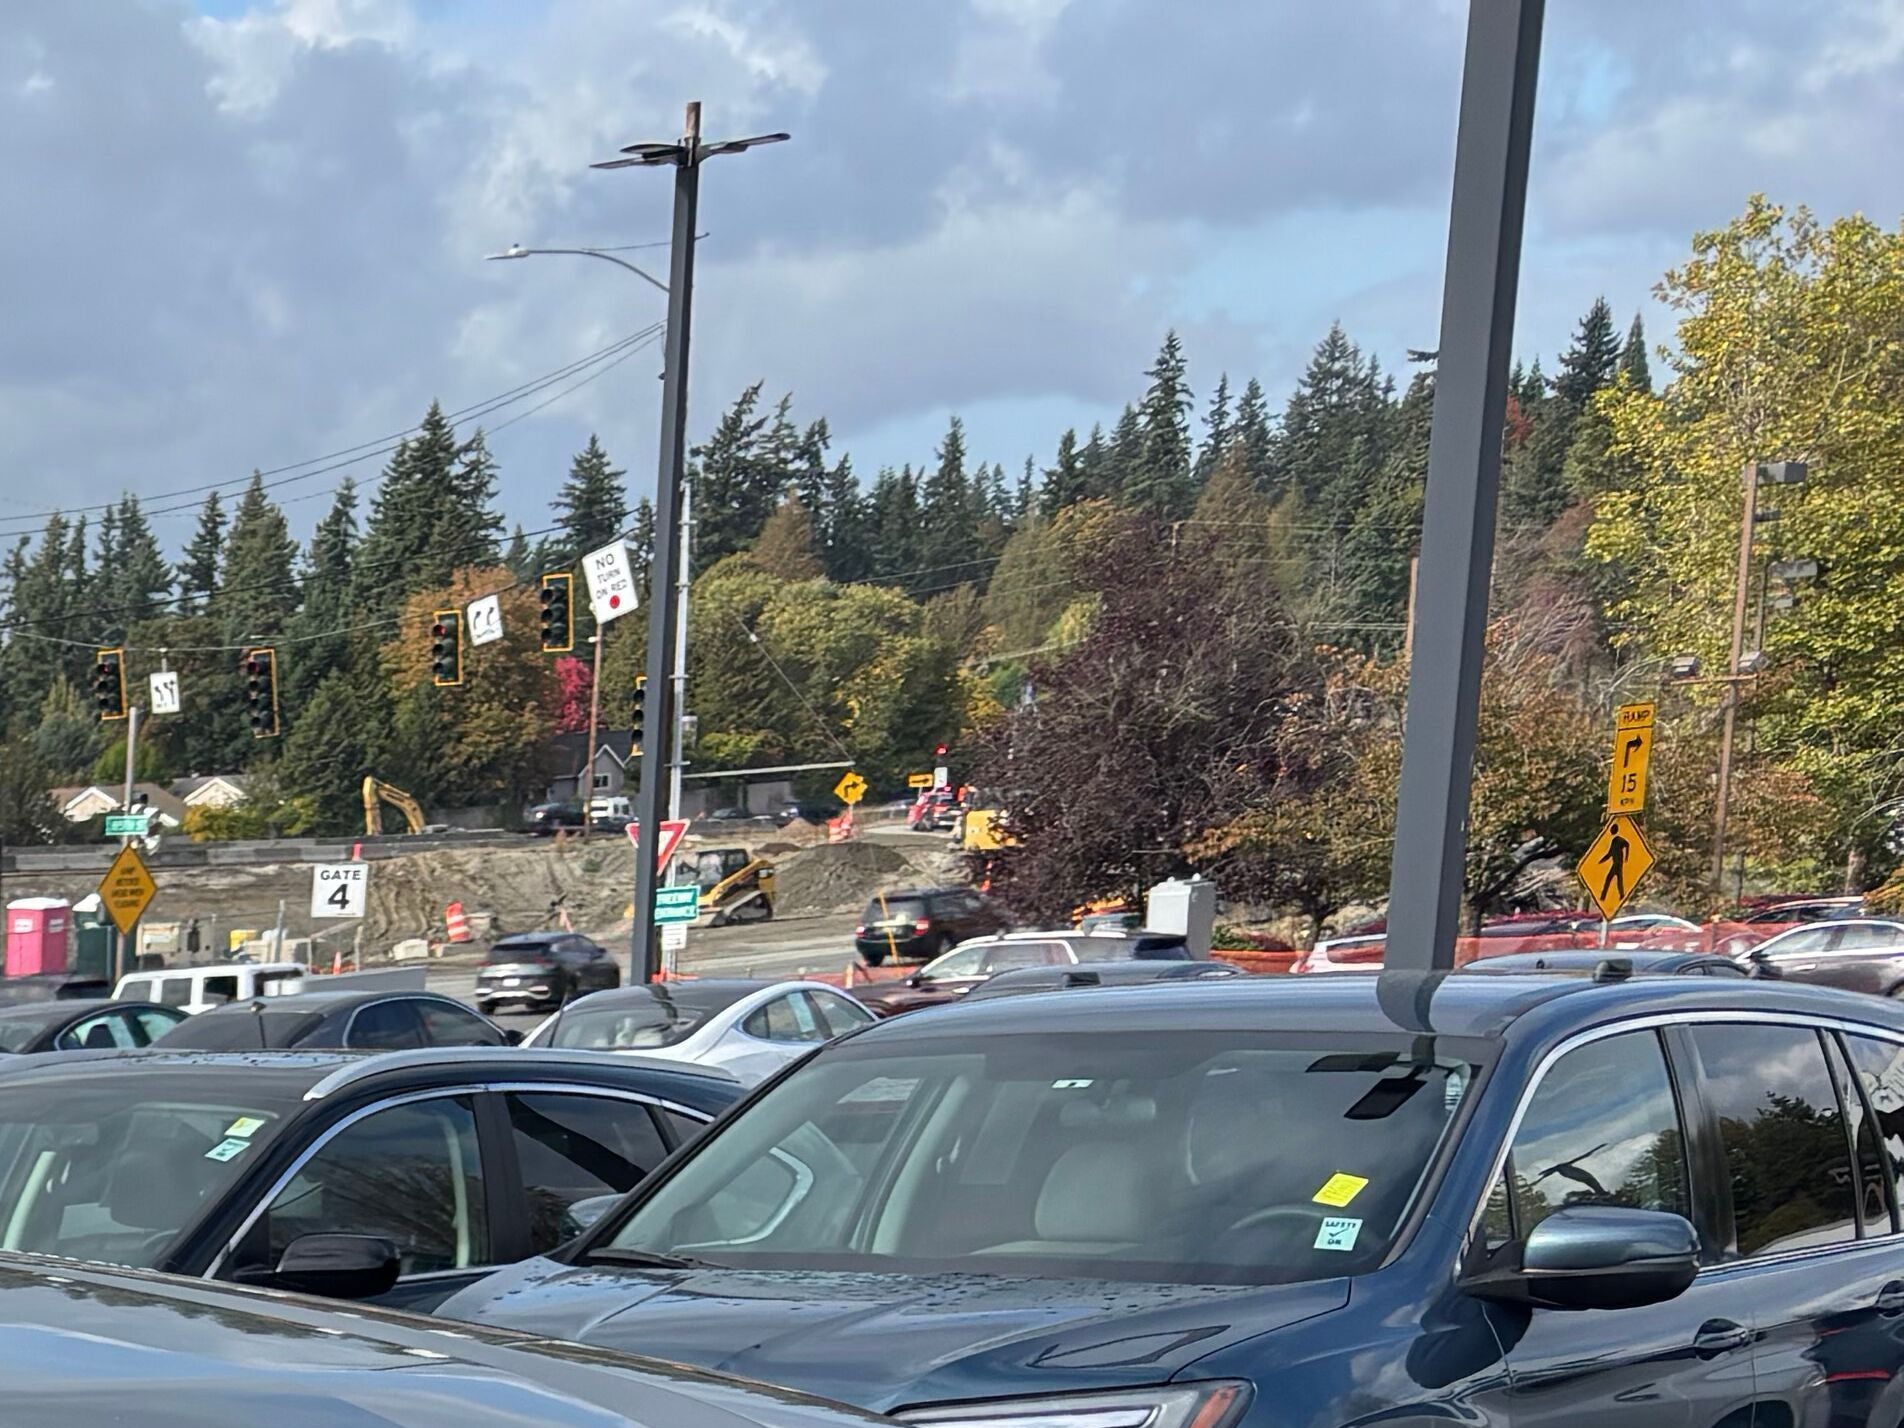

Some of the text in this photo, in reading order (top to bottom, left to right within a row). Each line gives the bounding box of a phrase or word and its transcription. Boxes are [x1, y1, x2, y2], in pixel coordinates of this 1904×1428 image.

[595, 553, 615, 570] NO
[597, 568, 621, 584] TURN
[596, 578, 628, 600] ON RED
[1620, 773, 1638, 793] 15
[320, 869, 362, 881] GATE
[327, 883, 350, 910] 4
